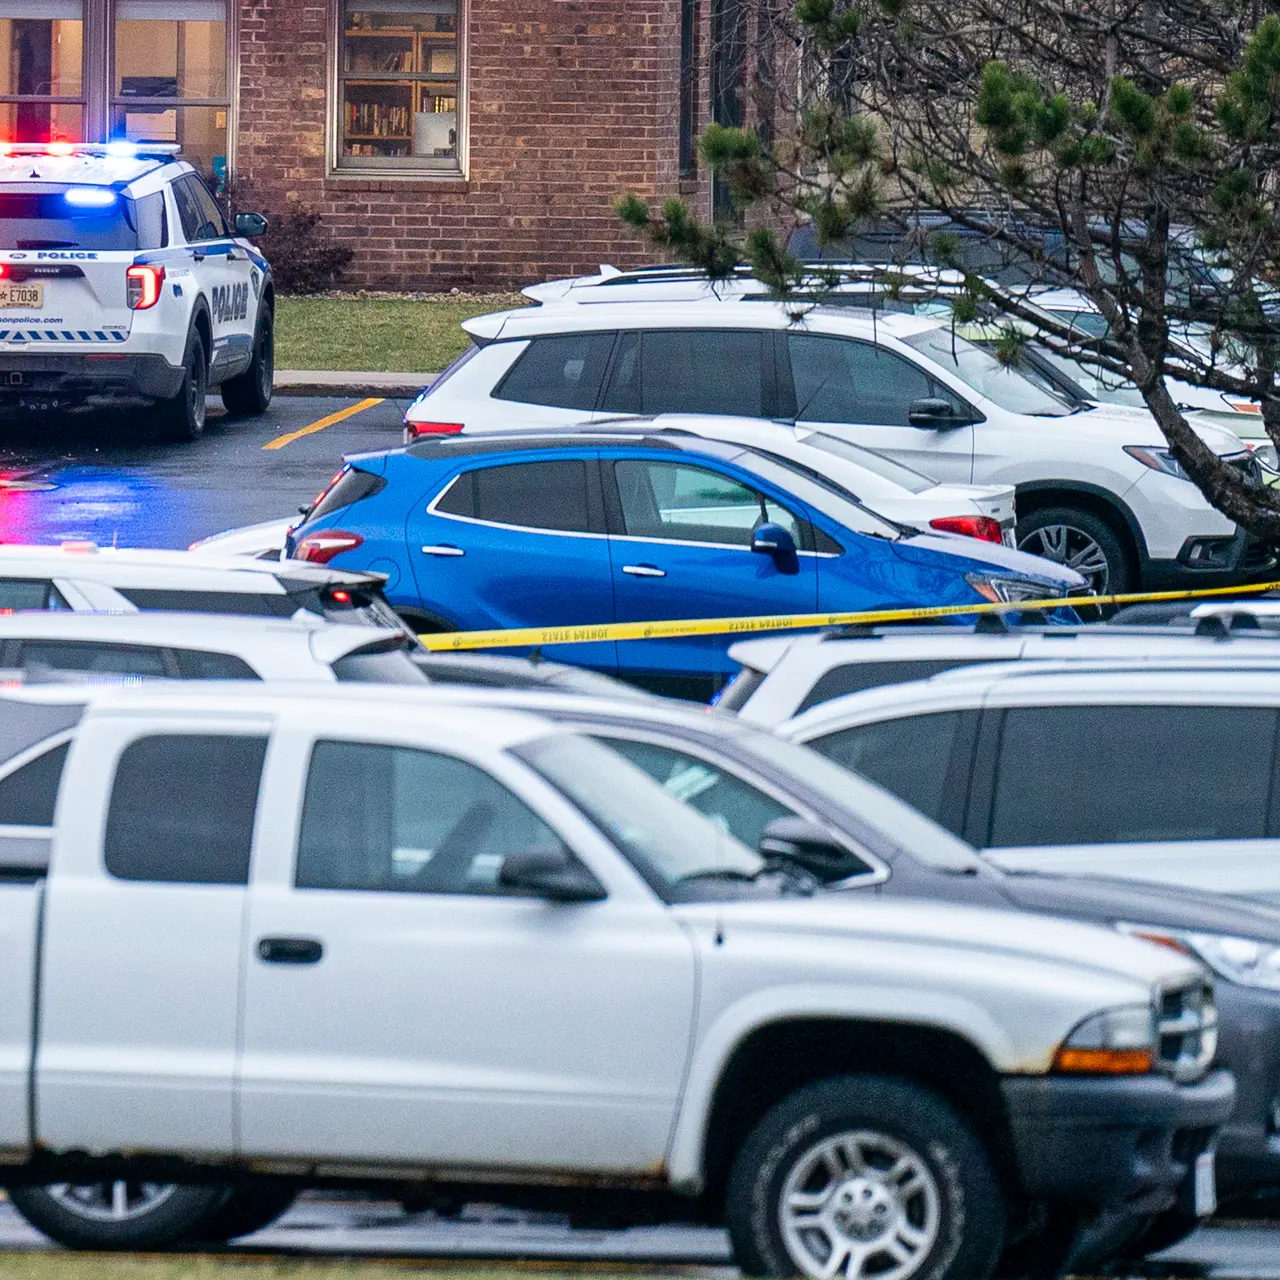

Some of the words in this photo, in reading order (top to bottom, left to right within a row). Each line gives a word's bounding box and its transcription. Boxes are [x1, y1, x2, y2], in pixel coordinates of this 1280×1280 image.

[37, 251, 99, 260] POLICE
[10, 289, 39, 302] E7038
[211, 281, 249, 325] POLICE
